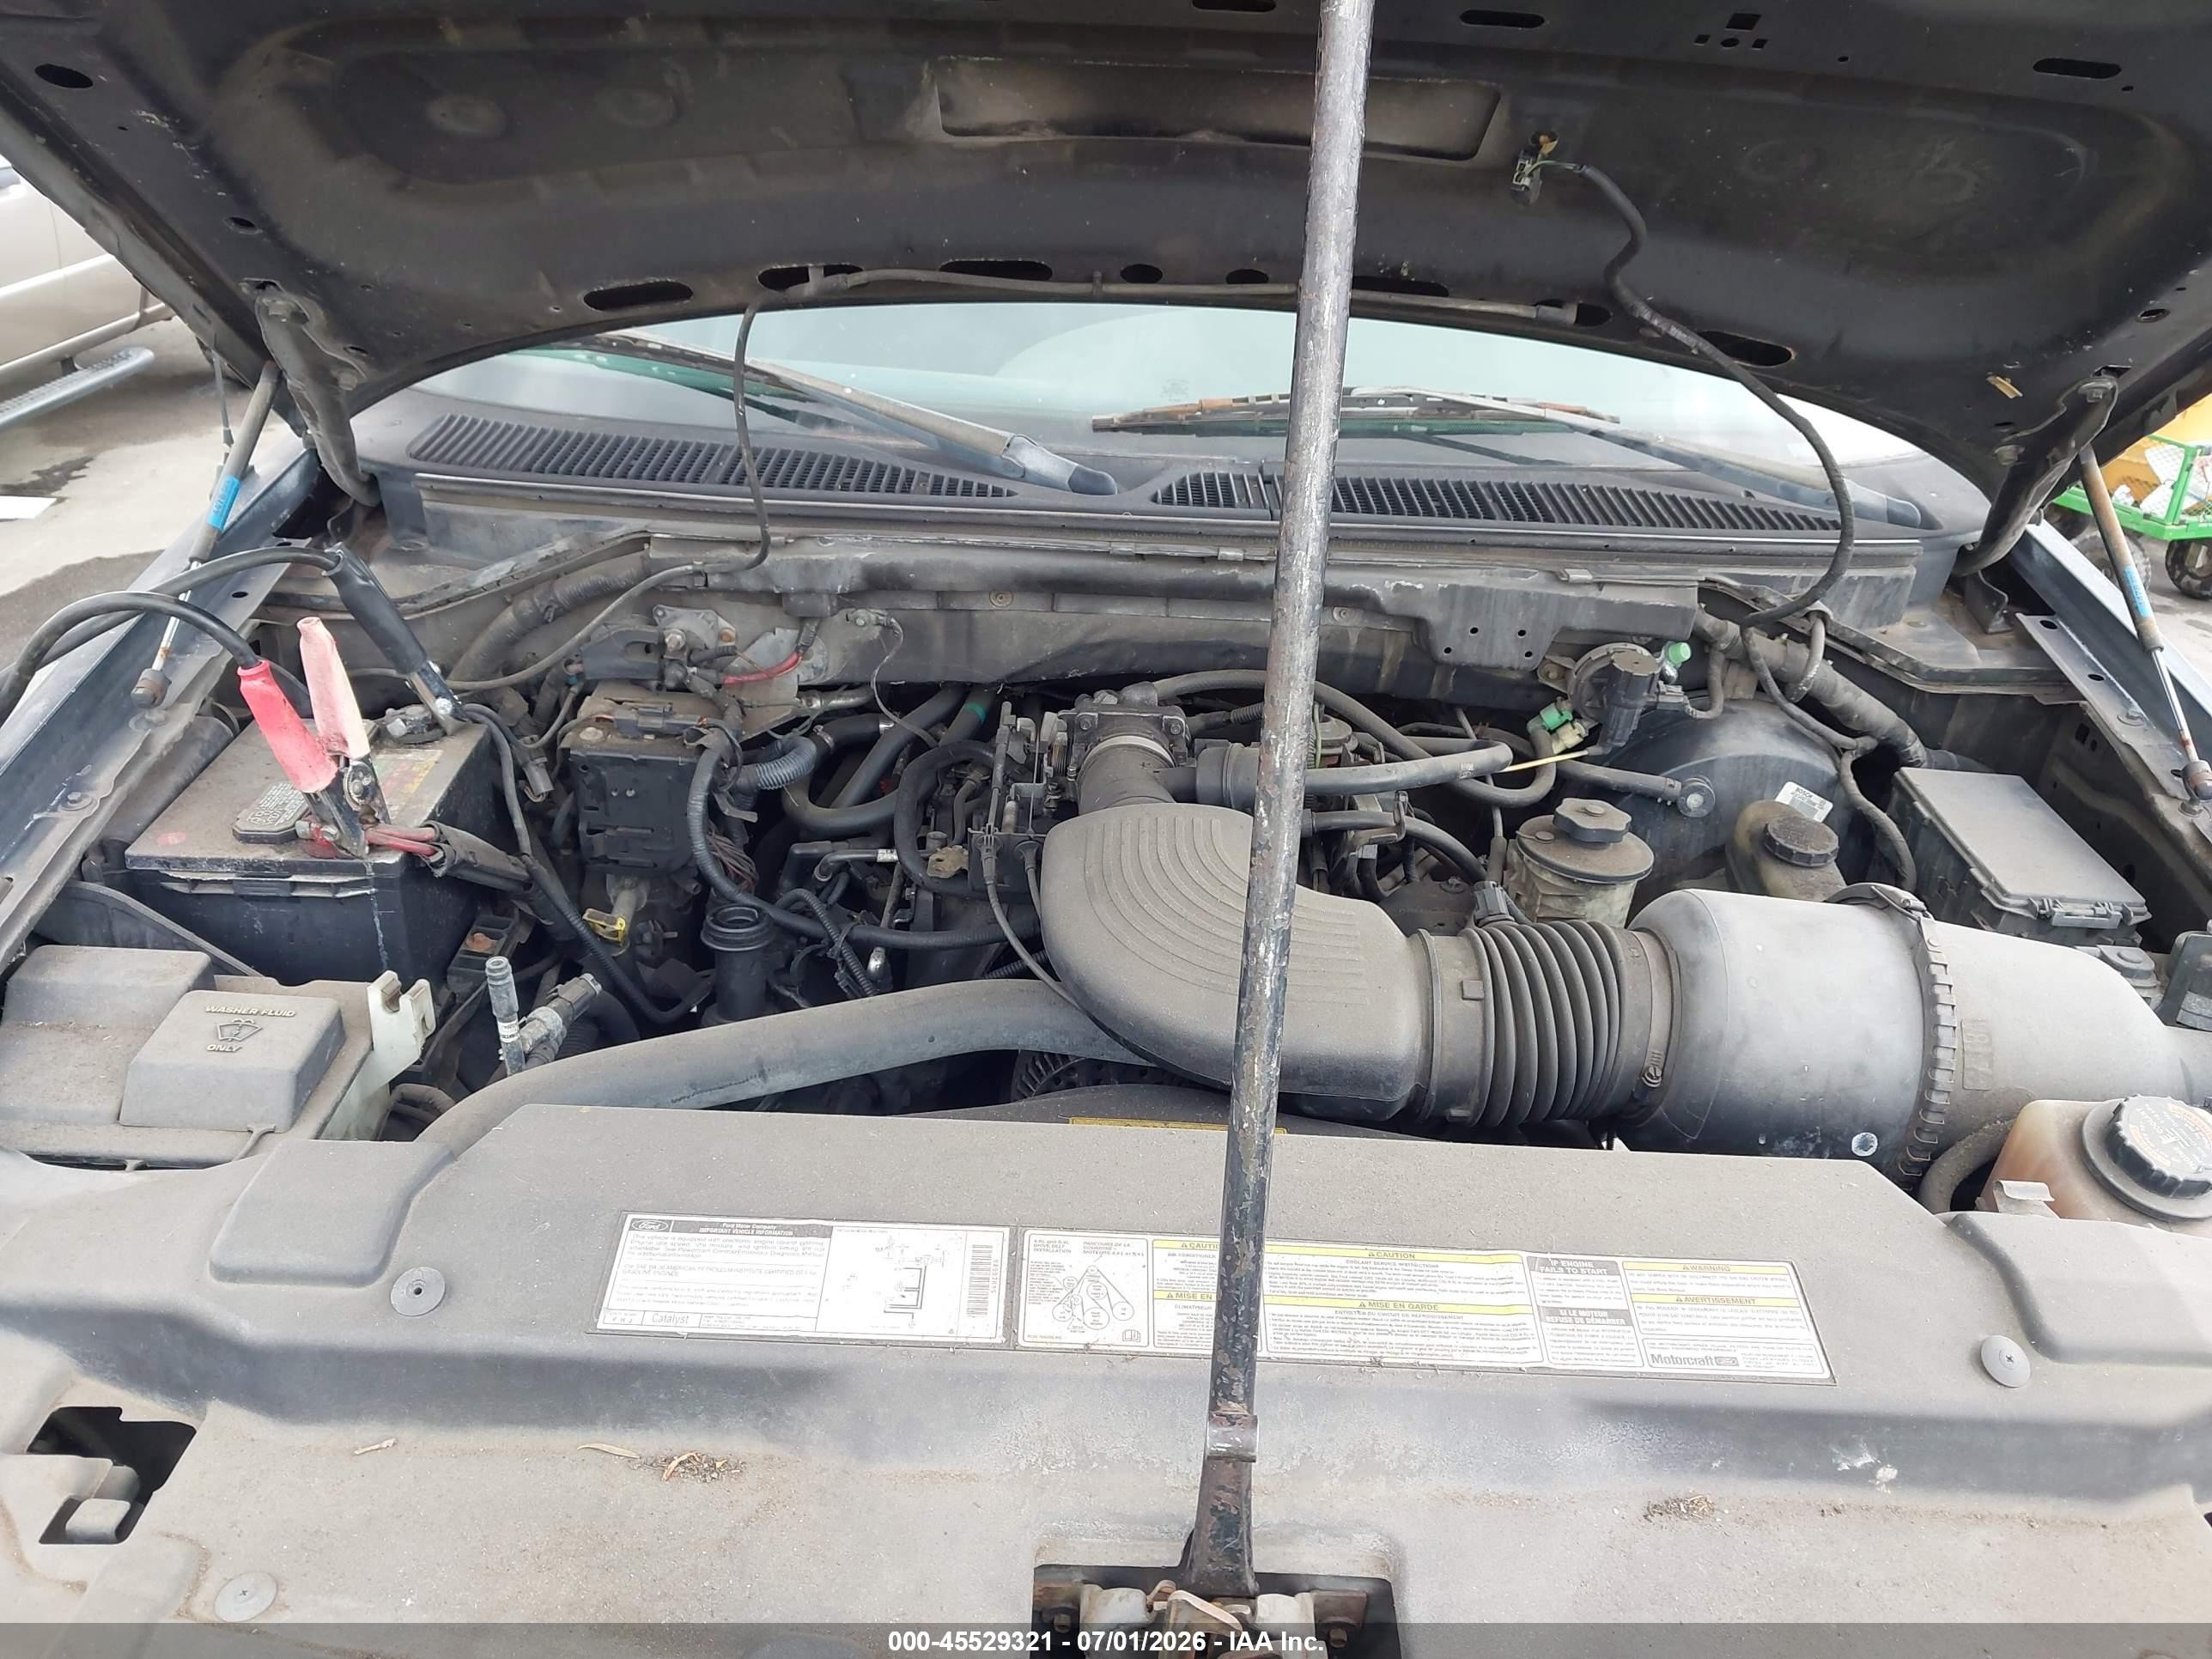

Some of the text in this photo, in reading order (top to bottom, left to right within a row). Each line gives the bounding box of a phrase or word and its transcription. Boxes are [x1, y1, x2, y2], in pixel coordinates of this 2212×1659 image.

[205, 1006, 296, 1018] WASHER FLUID
[207, 1044, 242, 1053] ONLY
[638, 1221, 661, 1230] Ford
[1688, 1264, 1731, 1273] WARNING
[1684, 1296, 1757, 1305] AVERTISSEMENT
[1407, 1303, 1439, 1311] GARDE
[652, 1313, 689, 1325] Catalyst
[1650, 1353, 1714, 1367] Motorcraft
